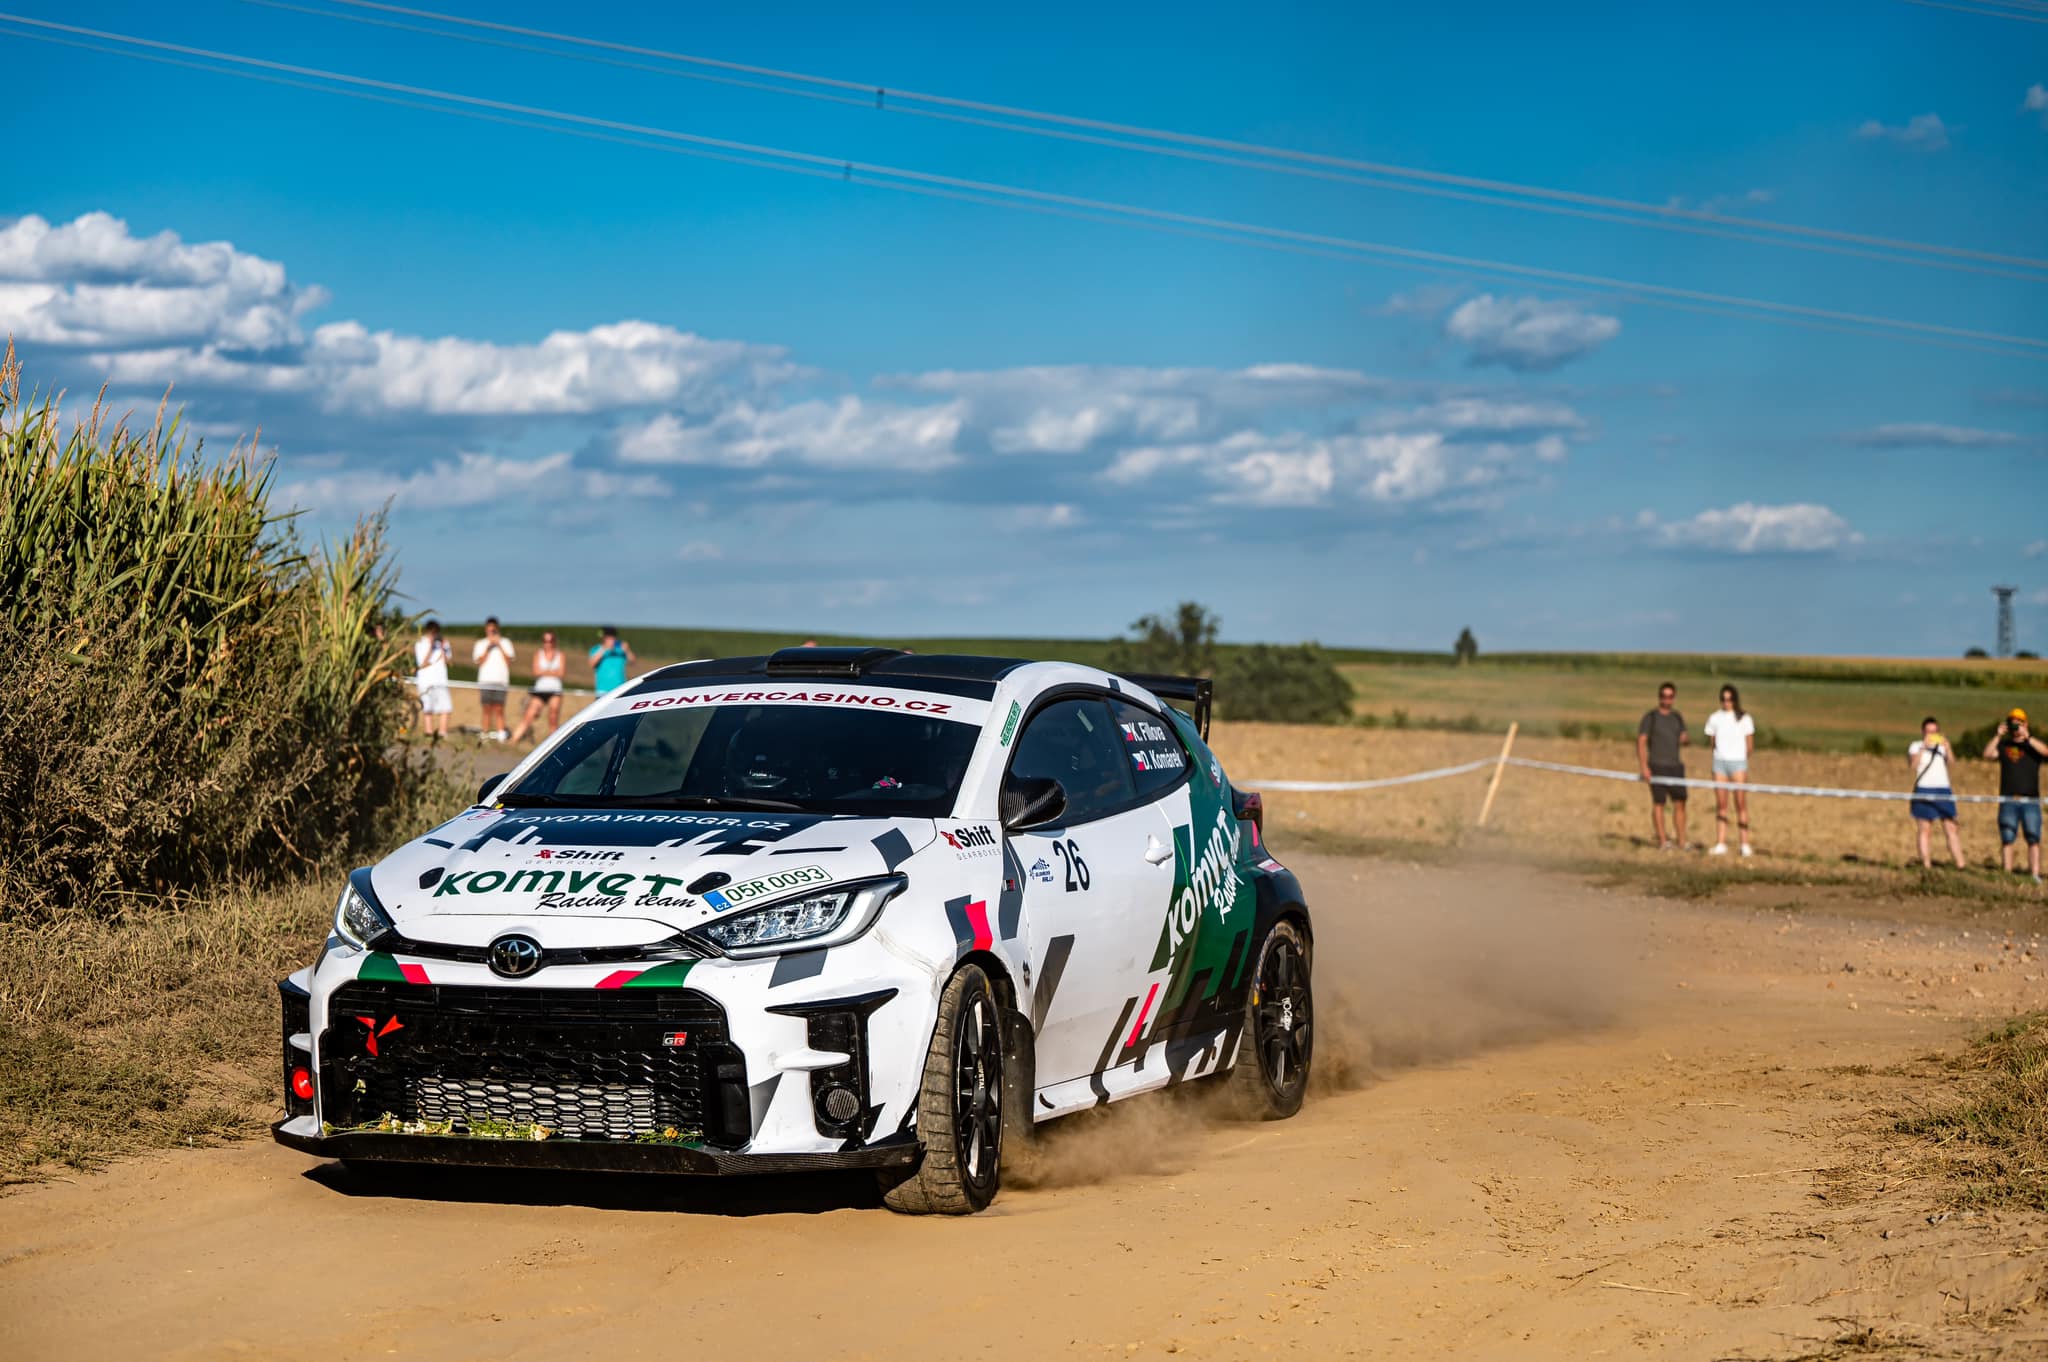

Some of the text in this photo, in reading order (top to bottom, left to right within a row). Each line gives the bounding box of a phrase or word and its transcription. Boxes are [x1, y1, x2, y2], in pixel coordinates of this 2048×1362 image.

[629, 691, 953, 714] BONVERCASINO.CZ
[1052, 838, 1090, 893] 26
[724, 867, 825, 902] 05R 0093
[534, 892, 698, 913] Racing team
[715, 902, 731, 911] CZ
[664, 1037, 686, 1046] GR
